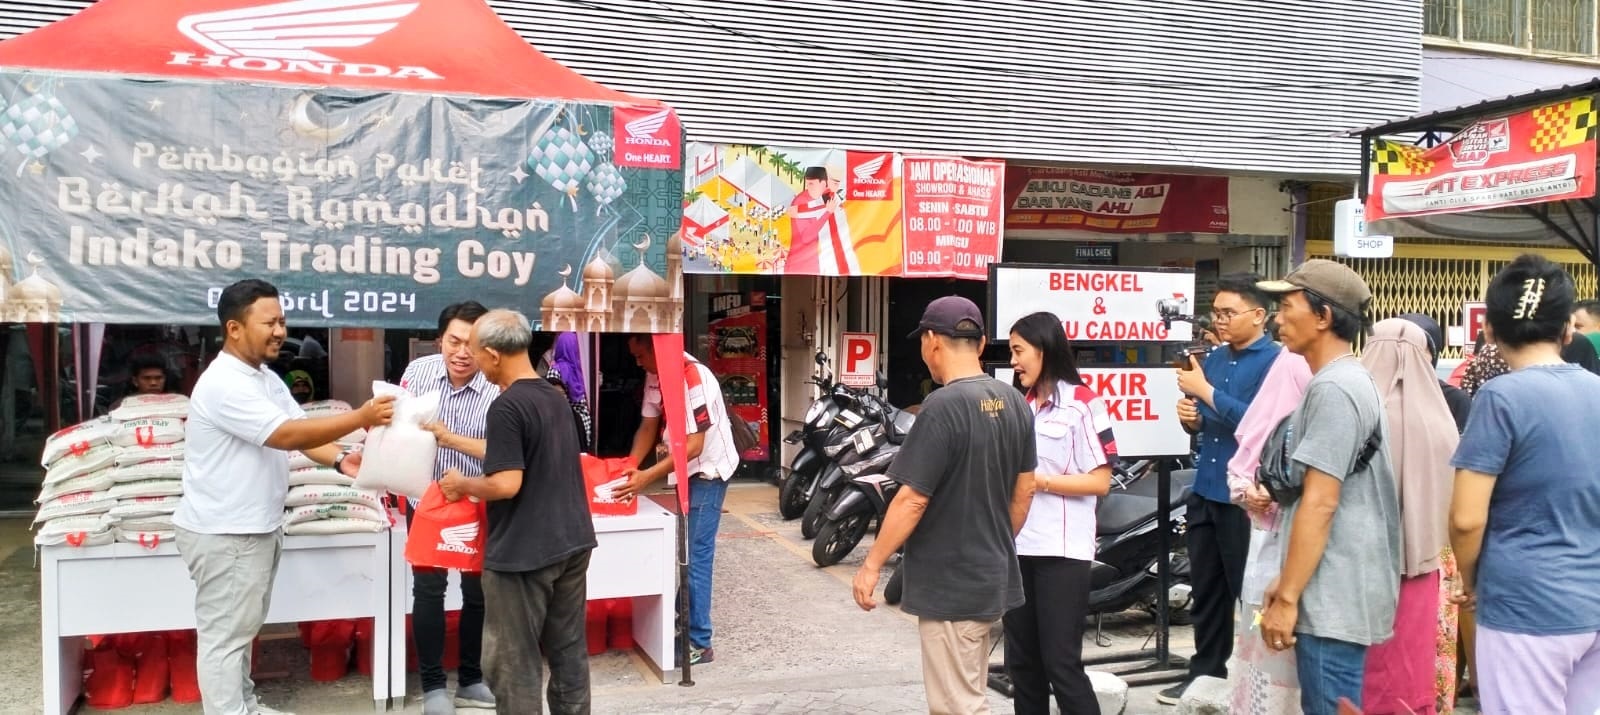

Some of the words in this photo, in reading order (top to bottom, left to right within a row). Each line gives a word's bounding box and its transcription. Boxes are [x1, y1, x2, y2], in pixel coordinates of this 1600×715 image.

[166, 51, 446, 80] HONDA
[625, 137, 671, 146] HONDA
[625, 152, 642, 162] One
[910, 161, 931, 181] JAM
[1460, 160, 1569, 191] EXPRESS
[853, 177, 887, 185] HONDA
[1069, 182, 1133, 200] CADANG
[1134, 185, 1165, 200] ASLI
[918, 201, 949, 213] SENIN
[955, 203, 989, 216] SABTU
[1055, 197, 1094, 212] YANG
[1095, 201, 1134, 214] AHLI
[909, 216, 941, 232] 08.00
[976, 221, 996, 235] WIB
[1357, 239, 1383, 249] SHOP
[69, 225, 243, 270] Indako
[260, 232, 442, 285] Trading
[456, 239, 536, 287] Coy
[909, 250, 941, 265] 09.00
[1049, 272, 1144, 293] BENGKEL
[279, 289, 335, 319] pril
[344, 290, 416, 313] 2024
[1092, 296, 1107, 315] &
[1085, 321, 1169, 340] CADANG
[846, 338, 872, 373] P
[436, 543, 479, 555] HONDA
